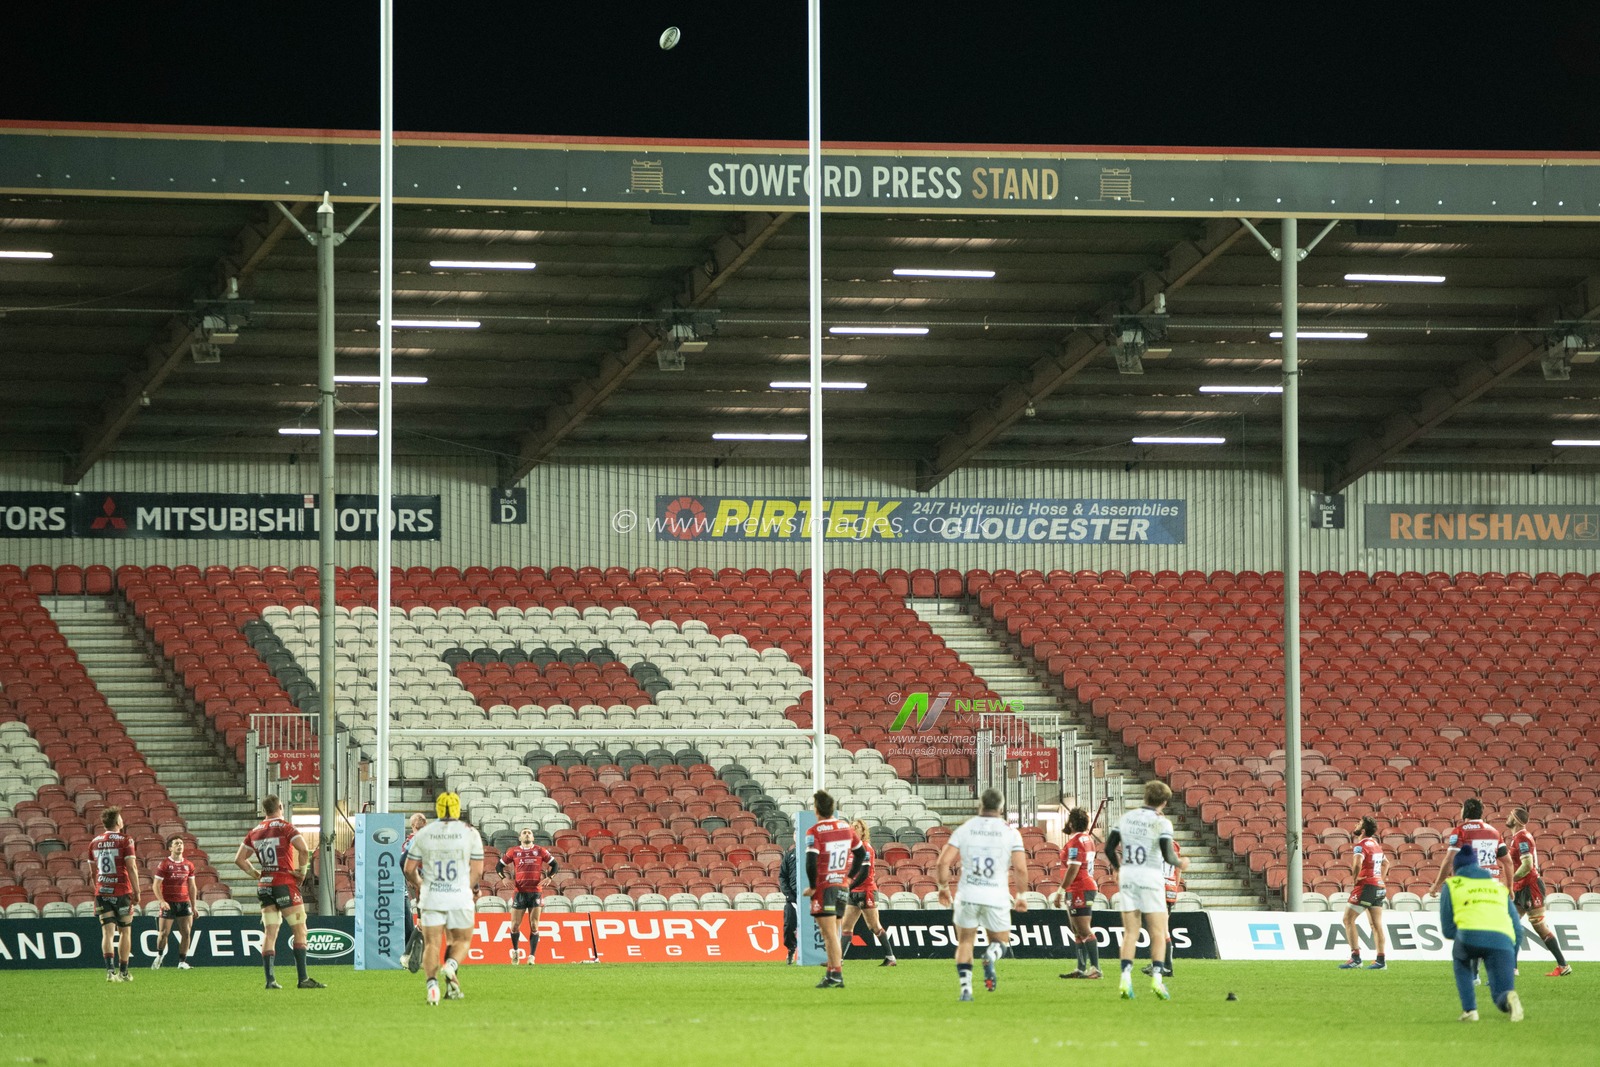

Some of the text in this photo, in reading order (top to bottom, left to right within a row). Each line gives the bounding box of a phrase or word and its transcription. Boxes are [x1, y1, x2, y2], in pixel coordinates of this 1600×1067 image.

[873, 166, 962, 199] PRESS
[971, 167, 1059, 200] STAND
[136, 506, 305, 532] MITSUBISHI
[501, 504, 517, 522] D
[711, 499, 902, 539] PIRTEK
[911, 502, 1179, 518] 24/7 Hydraulic Hose & Assemblies
[1322, 510, 1334, 528] E
[940, 517, 1150, 541] GLOUCESTER
[1390, 513, 1571, 541] RENISHAW
[102, 856, 111, 873] 8
[260, 847, 276, 865] 19
[829, 850, 847, 870] 16
[1125, 844, 1147, 865] 10
[434, 860, 458, 882] 16
[972, 856, 995, 879] 18
[374, 851, 395, 957] Gallagher
[306, 935, 334, 943] AND
[472, 918, 727, 942] HARTPURY
[873, 925, 1192, 948] MITSUBSHI MOTOS
[1293, 923, 1585, 951] PAVESNE
[468, 944, 722, 960] COLLEGE
